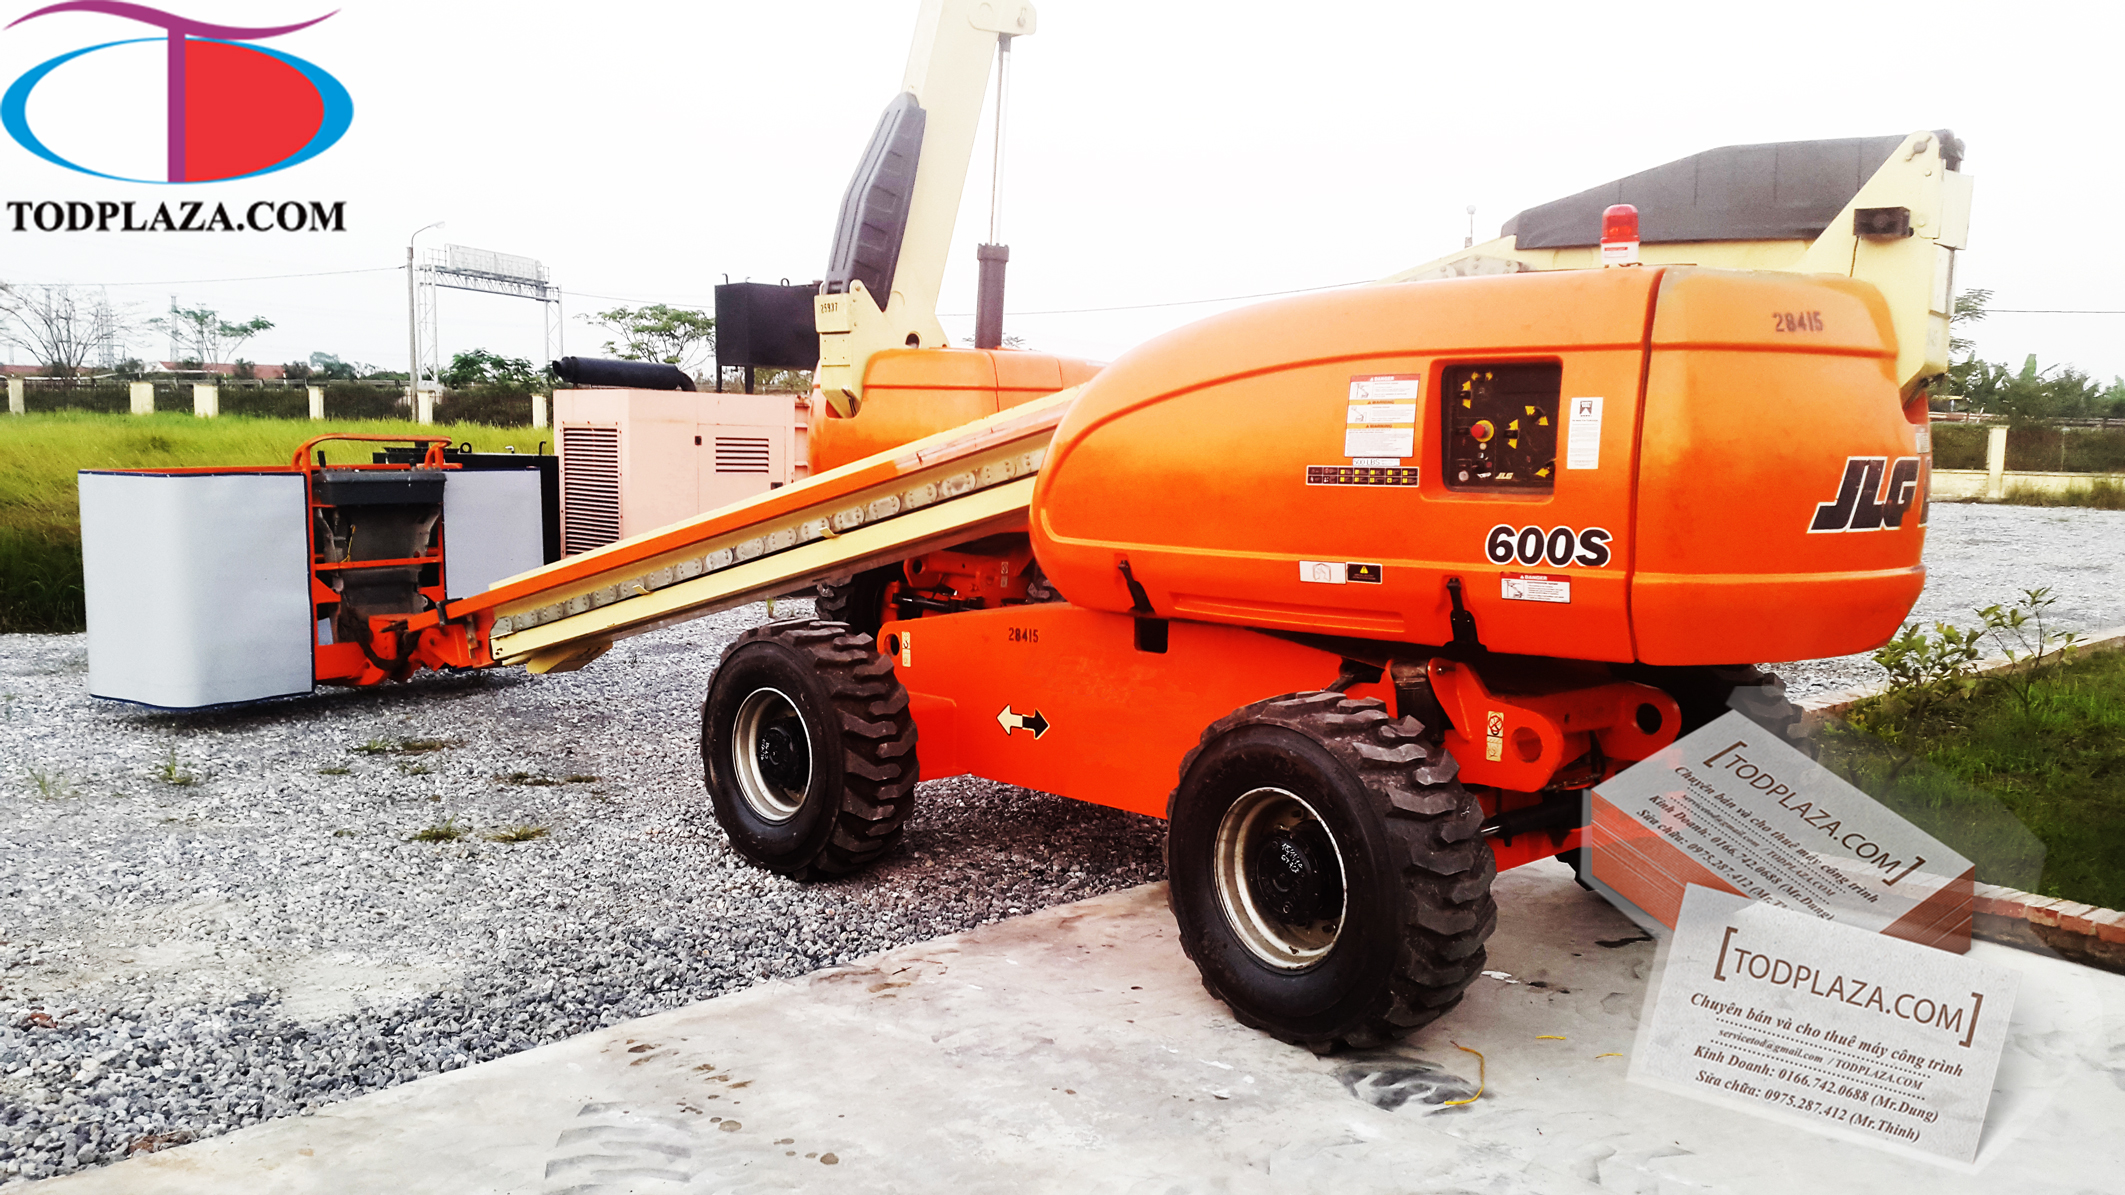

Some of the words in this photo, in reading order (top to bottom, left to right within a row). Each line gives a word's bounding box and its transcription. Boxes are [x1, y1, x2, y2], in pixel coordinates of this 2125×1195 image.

[1772, 311, 1823, 332] 28415
[1806, 456, 1920, 534] JLG
[1486, 525, 1612, 567] 600S
[1008, 627, 1039, 643] 28415
